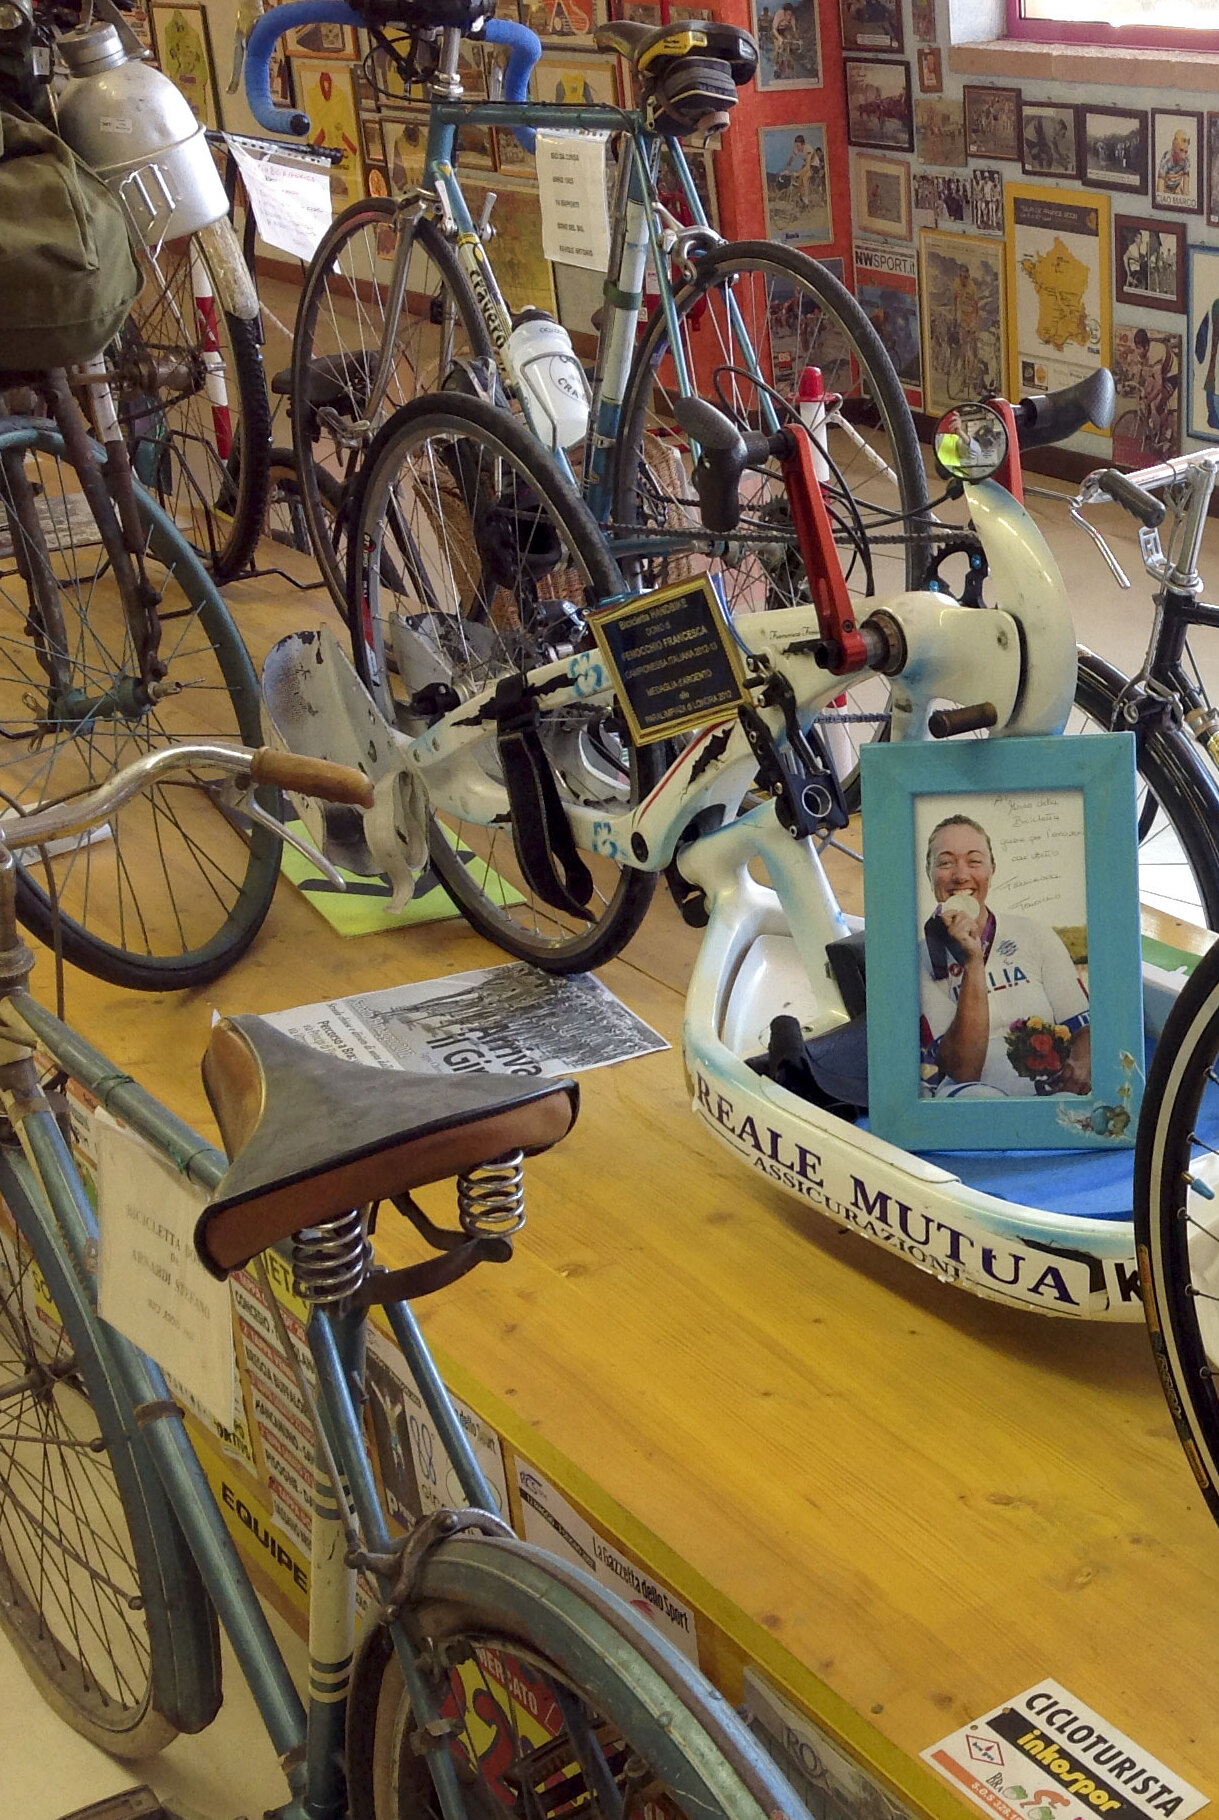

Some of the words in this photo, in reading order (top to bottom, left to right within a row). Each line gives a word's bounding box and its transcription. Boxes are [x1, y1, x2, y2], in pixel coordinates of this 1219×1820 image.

[470, 270, 506, 348] cravero
[662, 625, 707, 648] FRANCESCA
[318, 1017, 344, 1046] Percorso
[126, 1204, 181, 1251] BICICLETTA
[697, 1070, 824, 1188] REALE
[850, 1174, 1080, 1307] MUTUA
[753, 1155, 963, 1282] ASSICURAZIONI
[221, 1481, 308, 1594] EQUIPE
[592, 1536, 602, 1557] La
[602, 1550, 641, 1593] Gazzetta
[641, 1579, 664, 1612] dello
[663, 1592, 690, 1634] Sport
[1016, 1729, 1122, 1812] inkospor
[1025, 1692, 1184, 1818] CICLOTURISTA
